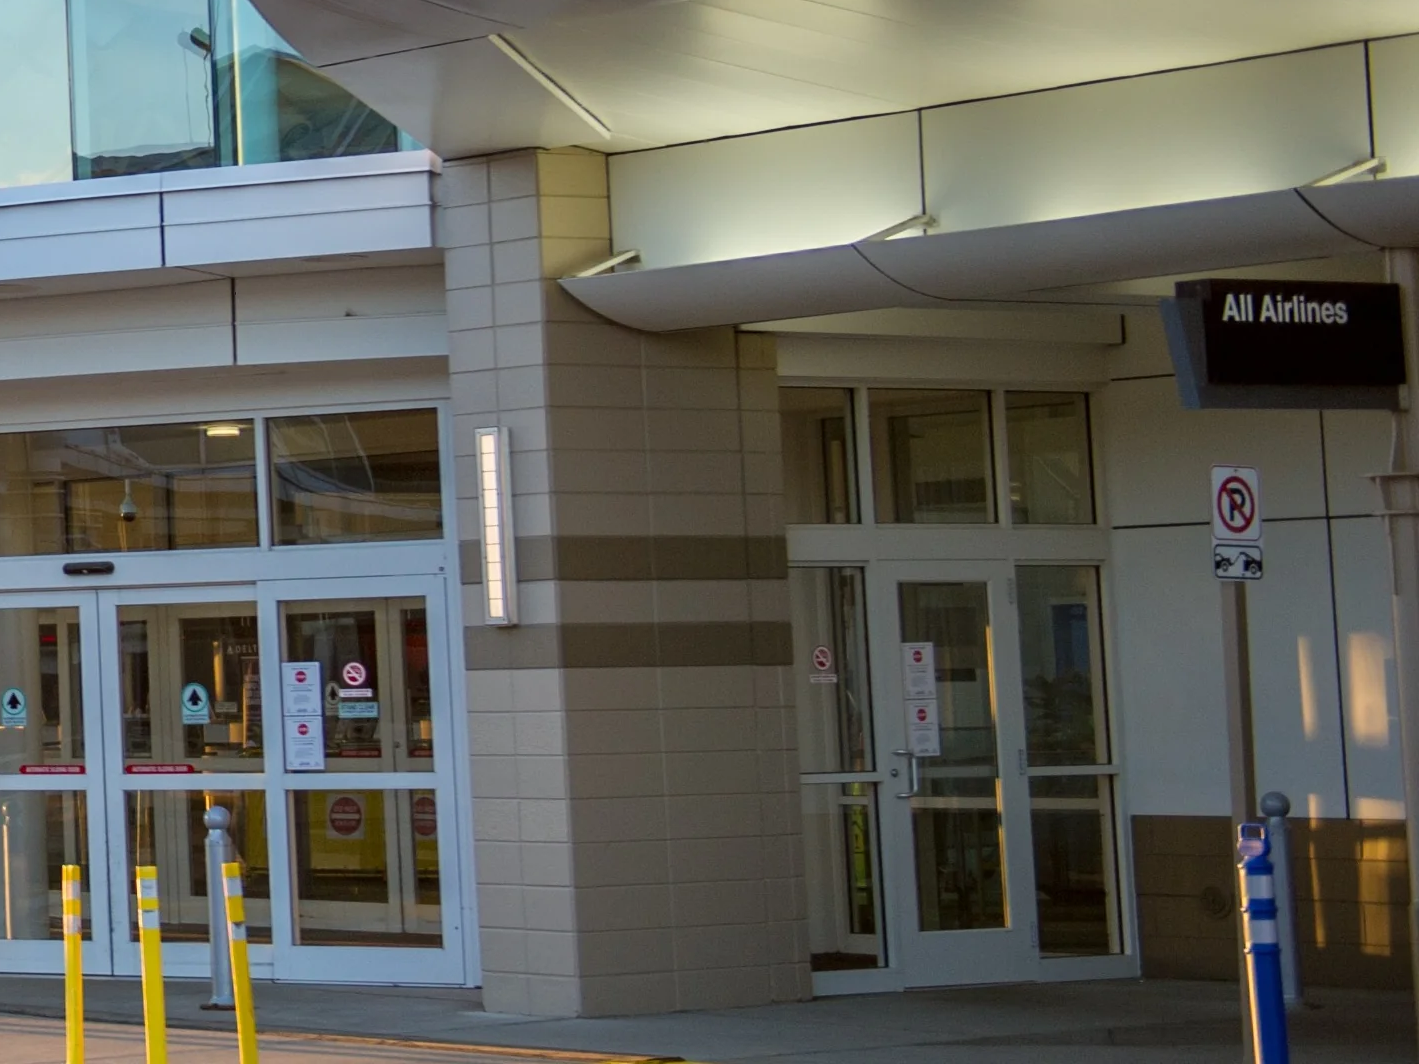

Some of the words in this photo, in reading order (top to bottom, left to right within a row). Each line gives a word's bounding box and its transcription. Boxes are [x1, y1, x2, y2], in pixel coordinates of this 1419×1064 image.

[1221, 293, 1254, 323] All
[1259, 293, 1349, 325] Airlines
[235, 644, 258, 653] DELT
